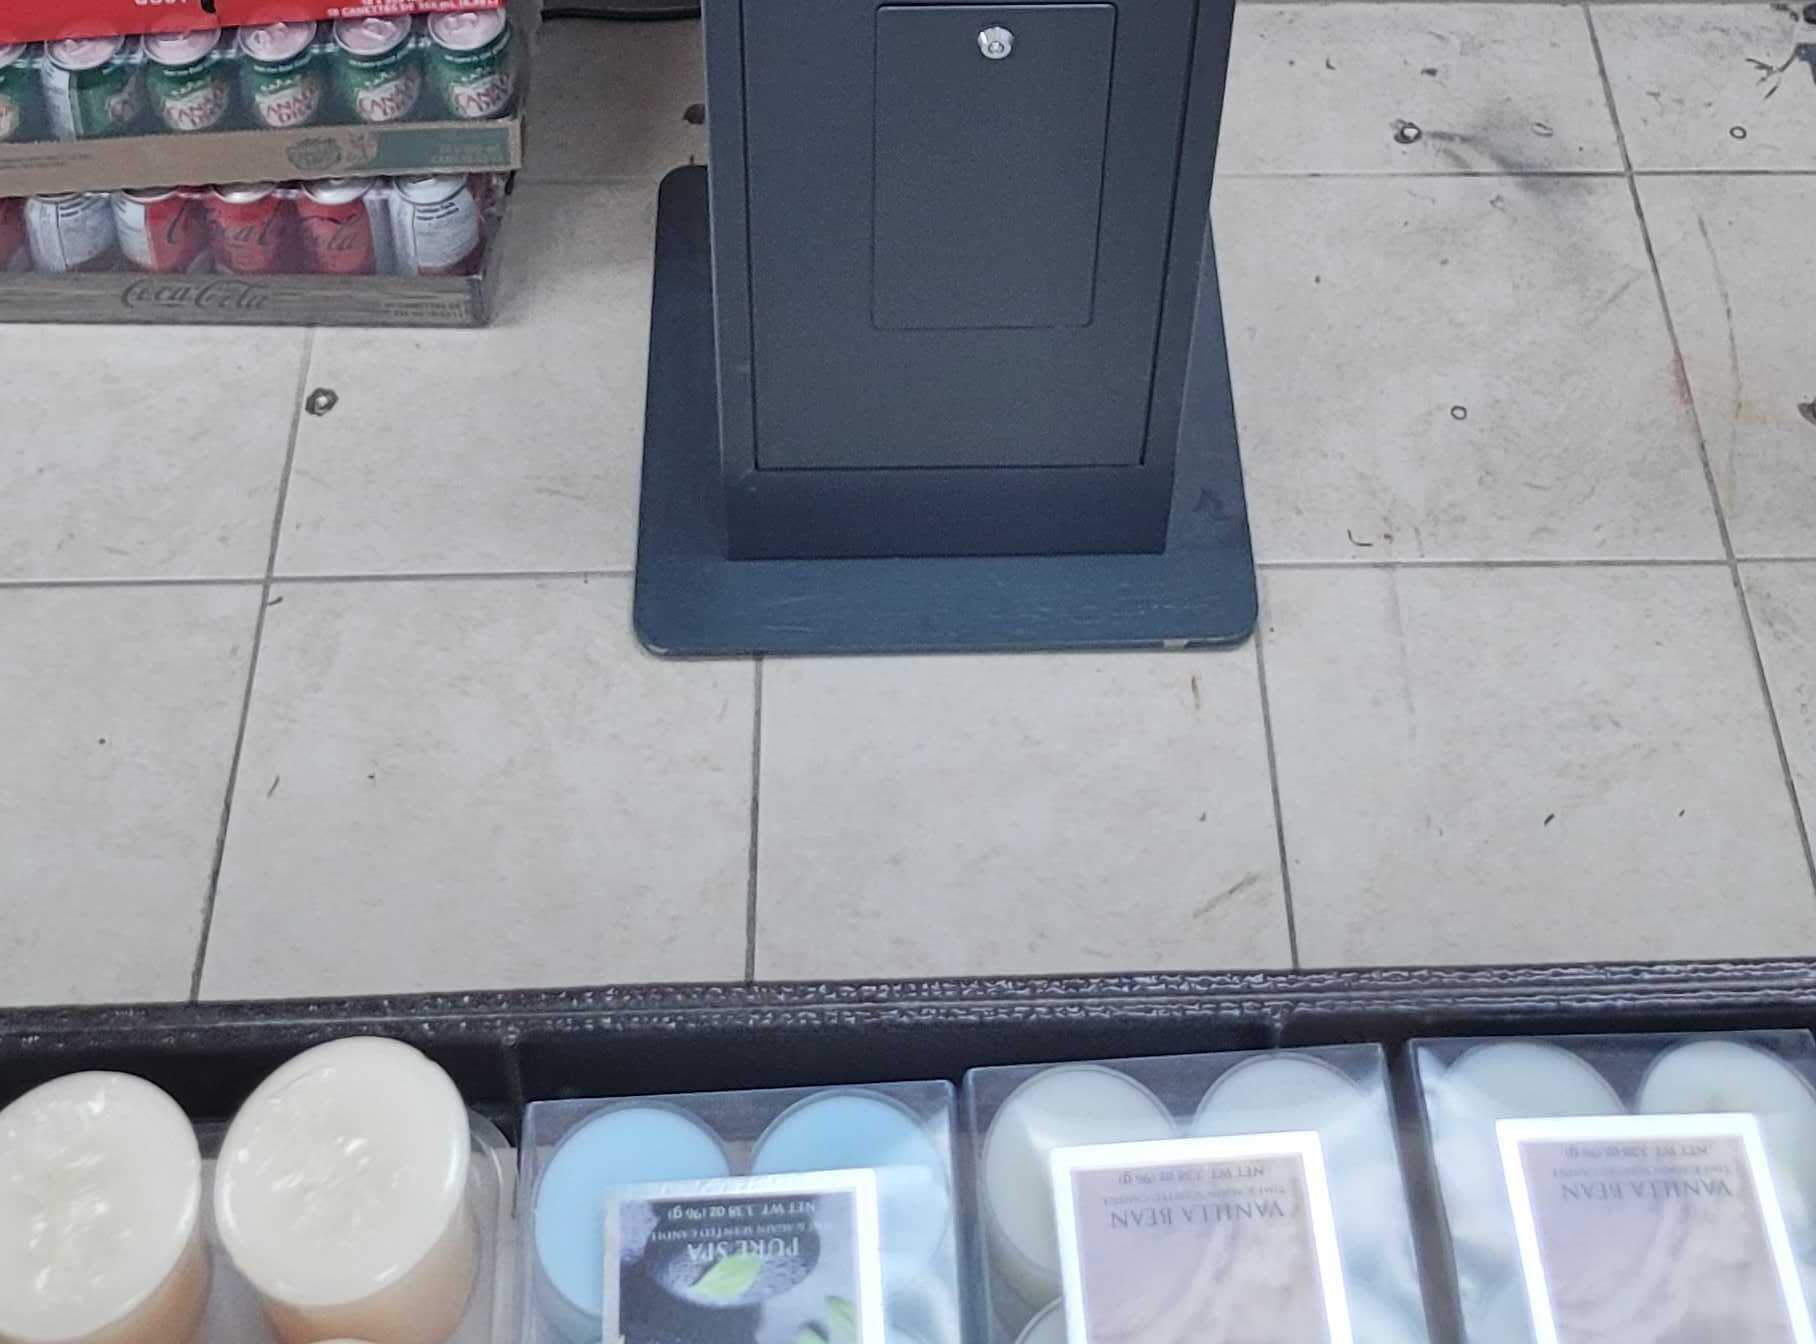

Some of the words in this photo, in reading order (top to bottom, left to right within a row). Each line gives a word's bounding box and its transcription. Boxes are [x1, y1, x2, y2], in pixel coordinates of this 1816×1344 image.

[121, 279, 269, 311] Coca-Cola
[1111, 1207, 1172, 1228] BEAN
[1184, 1200, 1285, 1225] VANILLA
[687, 1242, 728, 1261] SPA
[736, 1238, 799, 1258] PURE
